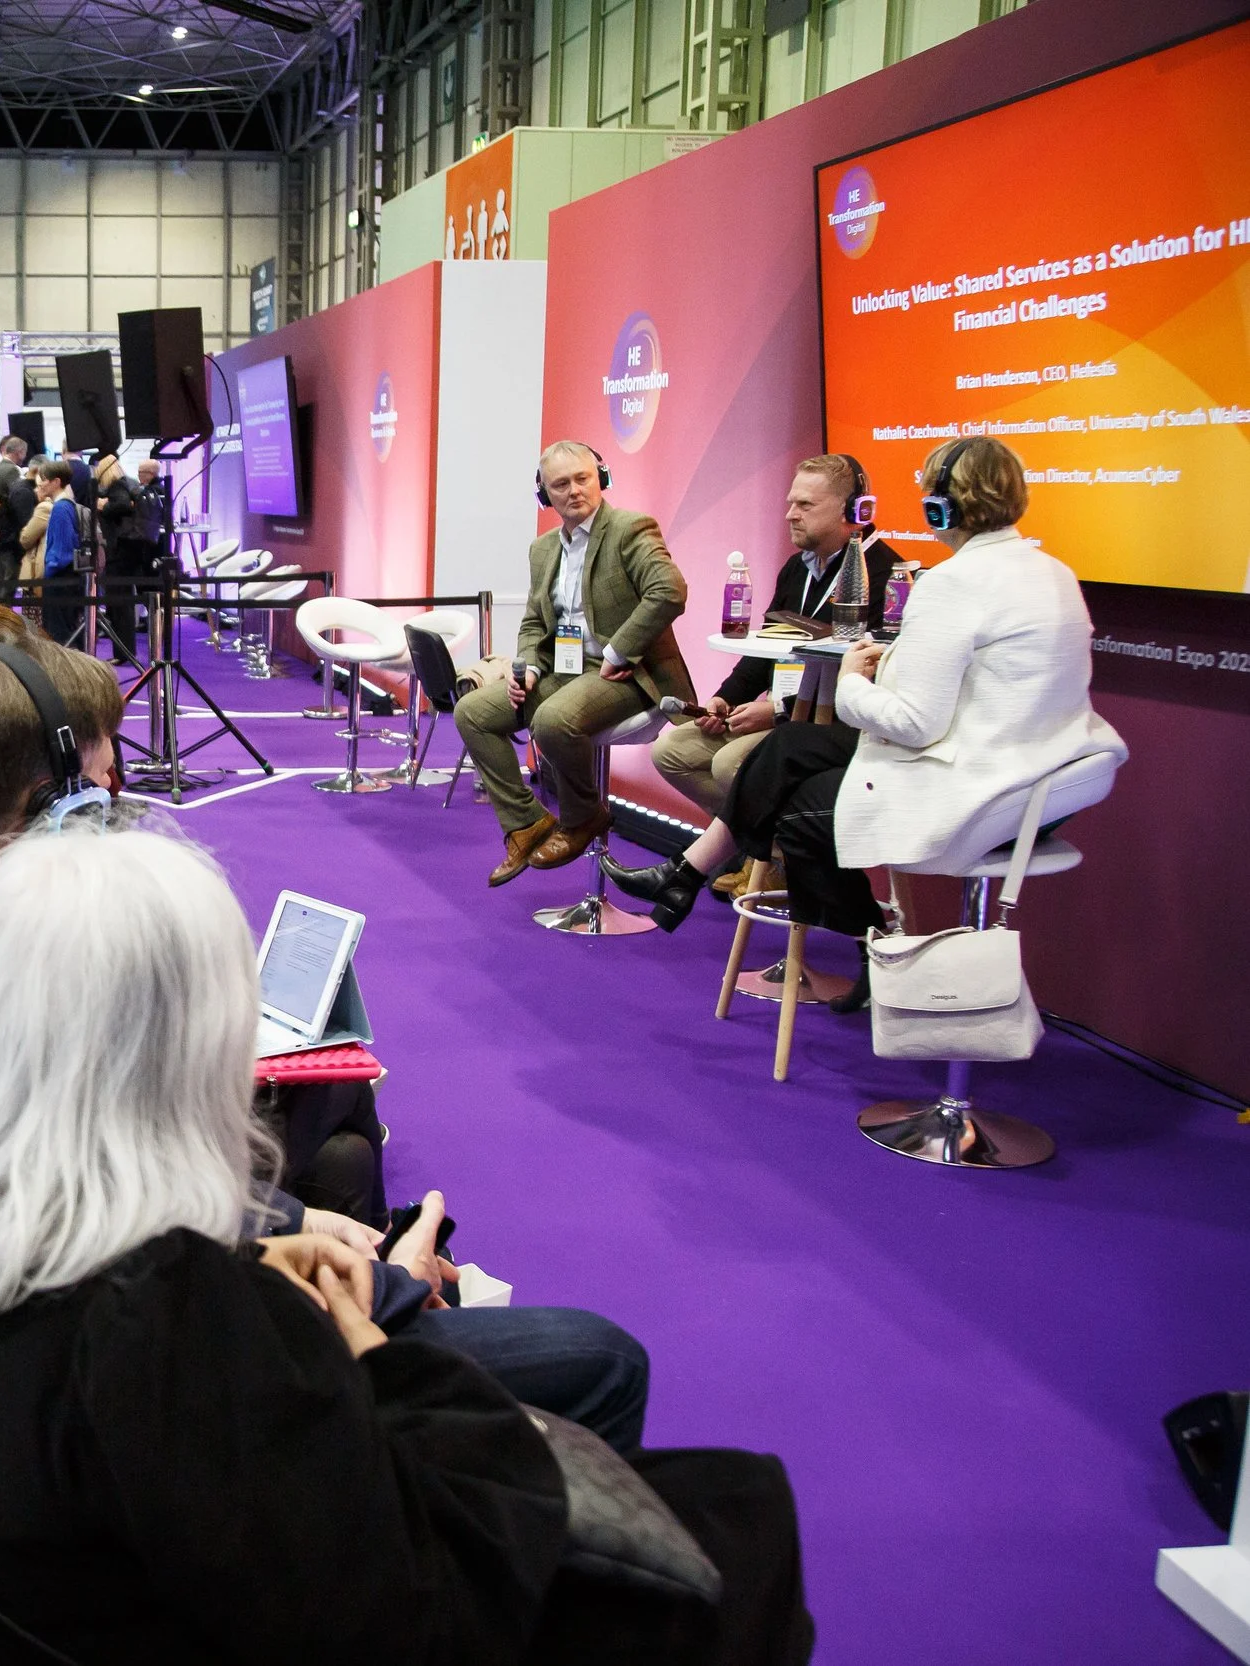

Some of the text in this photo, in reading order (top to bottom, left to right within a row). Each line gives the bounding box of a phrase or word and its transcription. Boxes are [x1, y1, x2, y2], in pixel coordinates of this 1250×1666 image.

[848, 189, 860, 203] HE
[828, 201, 885, 226] Transformation
[846, 220, 866, 235] Digital
[852, 289, 910, 315] Unlocking
[911, 281, 952, 304] Value:
[954, 267, 1004, 296] Shared
[1006, 259, 1070, 288] Services
[1072, 255, 1092, 275] as
[1095, 252, 1107, 271] a
[1110, 235, 1189, 269] Solution
[1193, 225, 1225, 252] for
[954, 292, 1106, 331] Financial Challenges
[628, 345, 641, 367] HE
[602, 369, 669, 395] Transformation
[956, 374, 982, 390] Brian
[982, 370, 1042, 387] Henderson,
[1043, 365, 1068, 383] CEO,
[622, 397, 645, 417] Digital
[873, 426, 908, 440] Nathalie
[908, 422, 960, 439] Czechowski,
[962, 420, 987, 436] Chief
[988, 419, 1046, 436] Information
[1048, 415, 1088, 433] Officer,
[1089, 412, 1150, 431] University
[1151, 409, 1167, 427] of
[1167, 408, 1207, 426] South
[1046, 468, 1093, 485] Director,
[1092, 635, 1172, 662] nsformation
[1176, 645, 1215, 670] Expo
